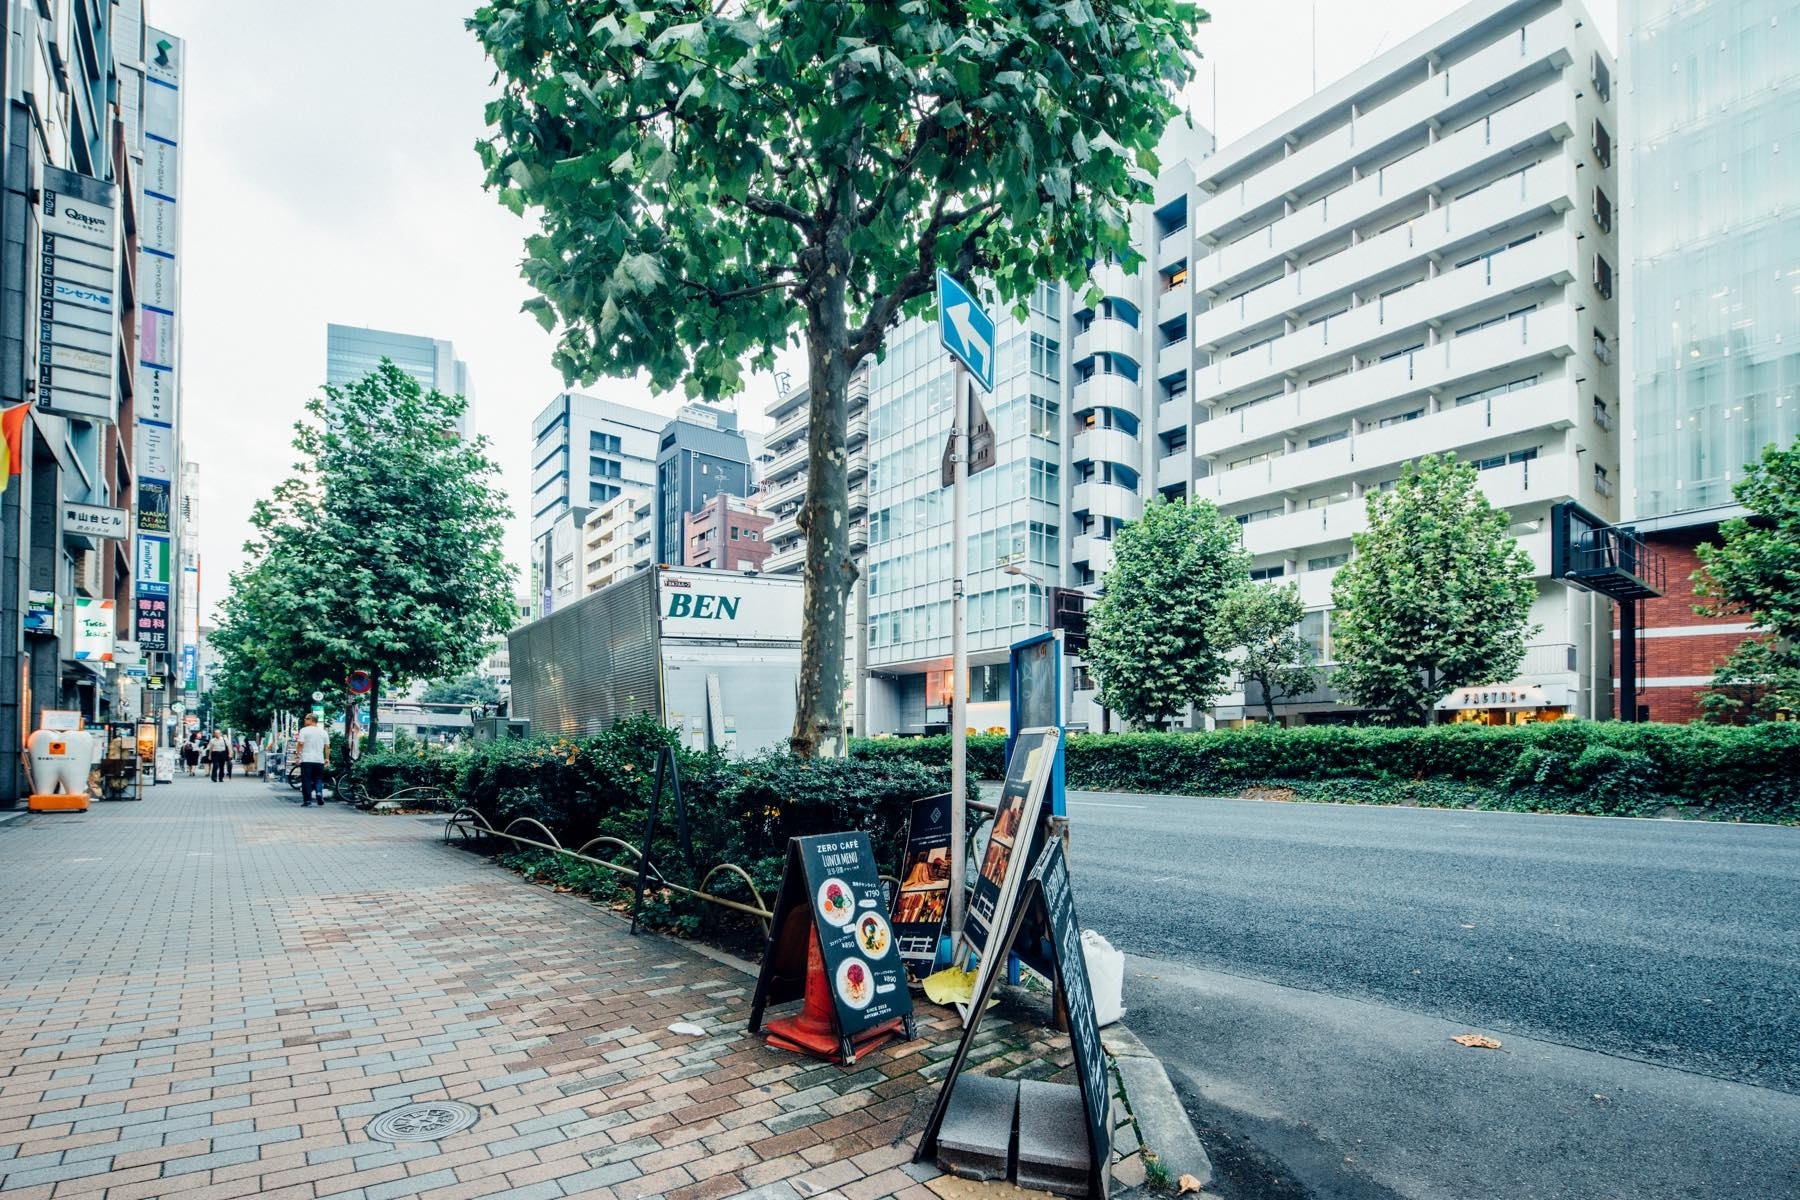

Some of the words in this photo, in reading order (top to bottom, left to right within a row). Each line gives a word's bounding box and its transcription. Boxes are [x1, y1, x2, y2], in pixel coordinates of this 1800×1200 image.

[67, 510, 121, 526] 青山台ビル
[144, 541, 153, 579] FamilyMart
[139, 600, 166, 611] 審美
[667, 592, 742, 620] BEN
[139, 618, 166, 629] 歯科
[138, 631, 165, 643] 矯正
[817, 843, 838, 853] ZERO
[840, 839, 859, 850] CAFÉ
[822, 854, 840, 867] LUNCH
[840, 851, 858, 866] MENU
[865, 889, 880, 898] ¥790
[841, 940, 855, 949] ¥890
[884, 975, 897, 983] ¥890
